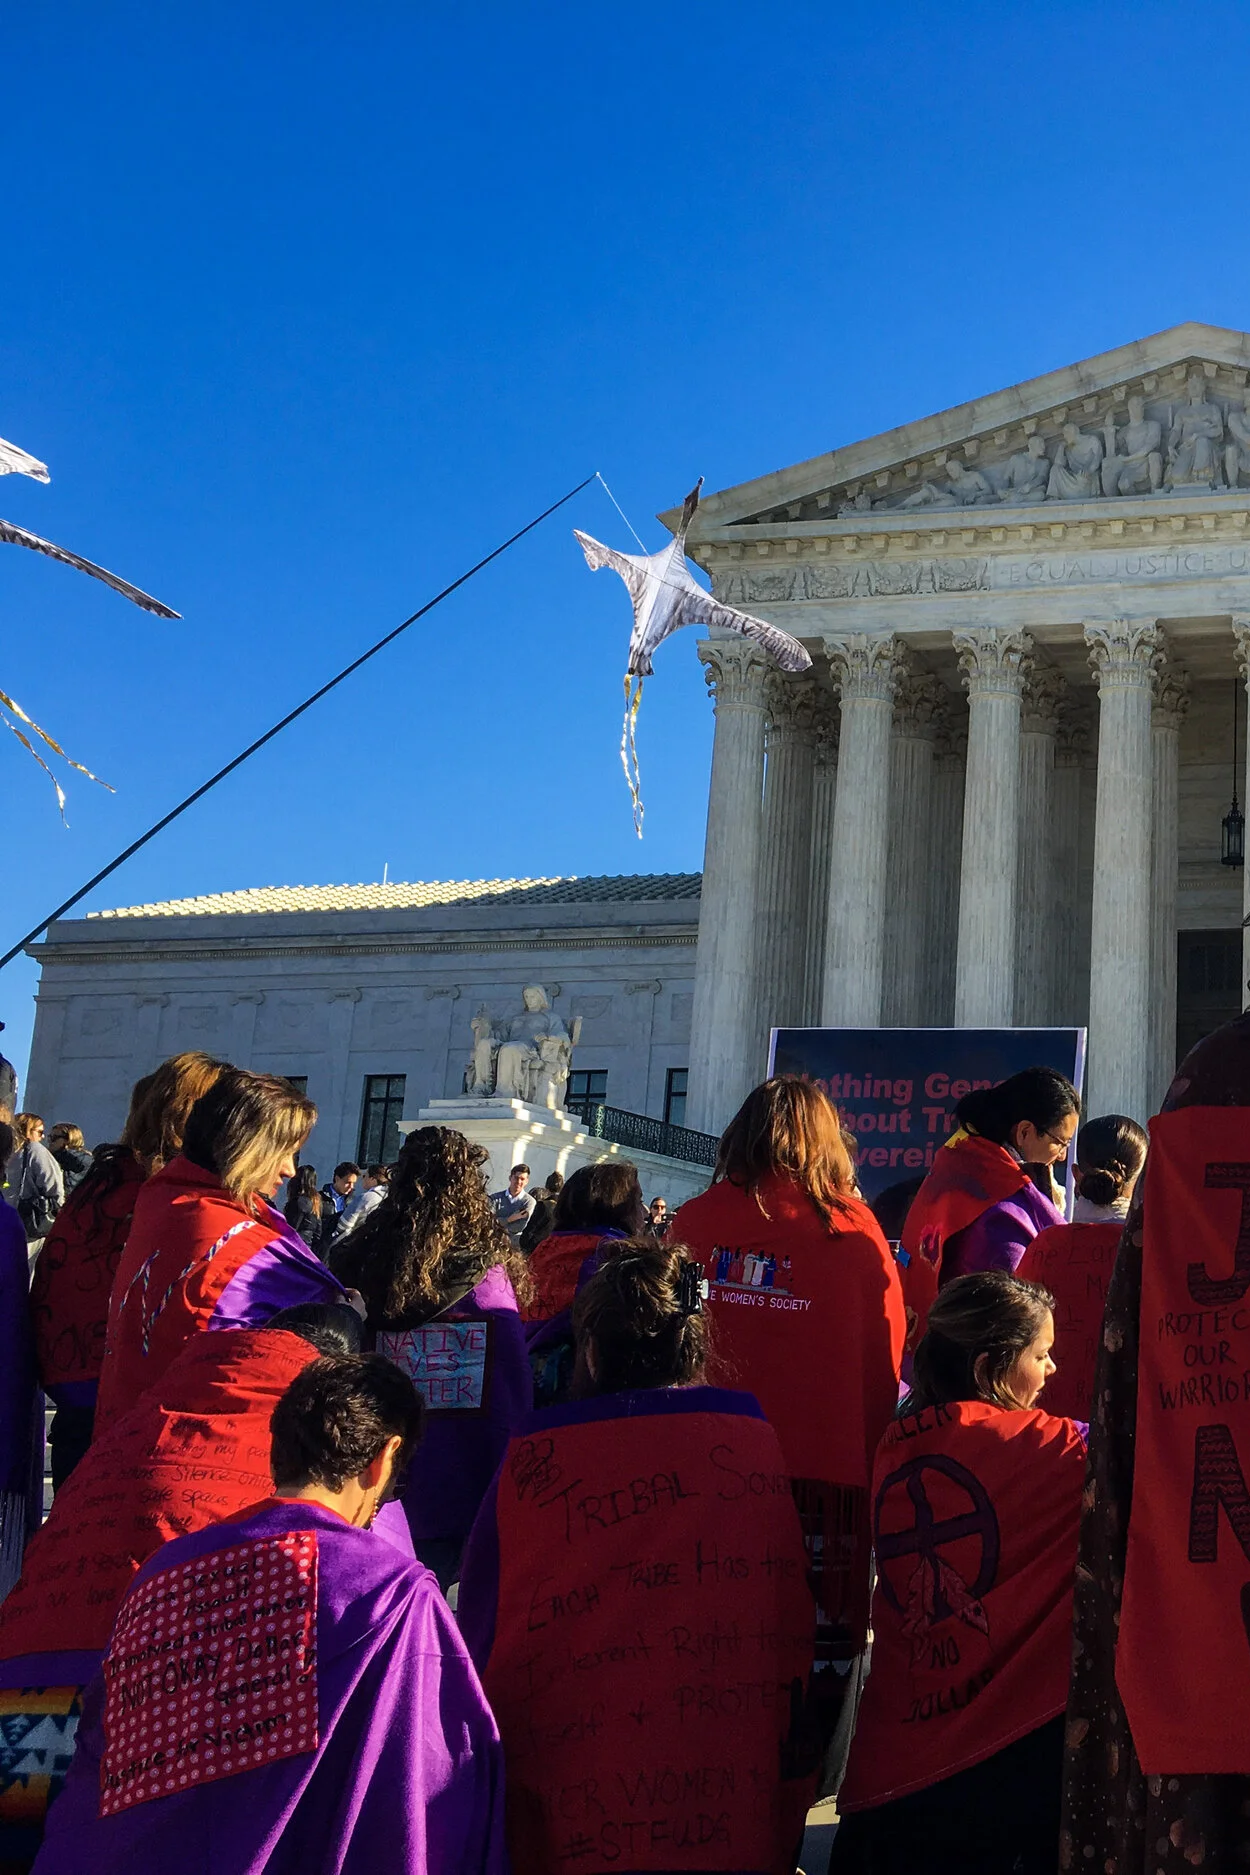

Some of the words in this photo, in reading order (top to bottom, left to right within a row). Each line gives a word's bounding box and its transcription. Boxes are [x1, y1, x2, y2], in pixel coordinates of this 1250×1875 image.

[1009, 559, 1101, 583] EQUAL
[1109, 552, 1214, 577] JUSTICE
[837, 1105, 912, 1133] bout
[721, 1291, 765, 1307] WOMEN'S
[769, 1297, 811, 1311] SOCIETY
[381, 1329, 485, 1353] NATIVE
[1183, 1339, 1237, 1367] OUR
[391, 1352, 461, 1375] IVES
[171, 1464, 230, 1482] Silence
[538, 1470, 701, 1545] TRIBAL
[182, 1553, 258, 1595] Sexual
[528, 1575, 601, 1632] EACH
[161, 1651, 221, 1695] OKAY
[236, 1628, 304, 1666] Dollar
[931, 1635, 961, 1670] NO
[214, 1663, 292, 1706] General
[672, 1679, 792, 1724] PROTE
[203, 1712, 288, 1747] Victim
[616, 1765, 736, 1808] WOMEN
